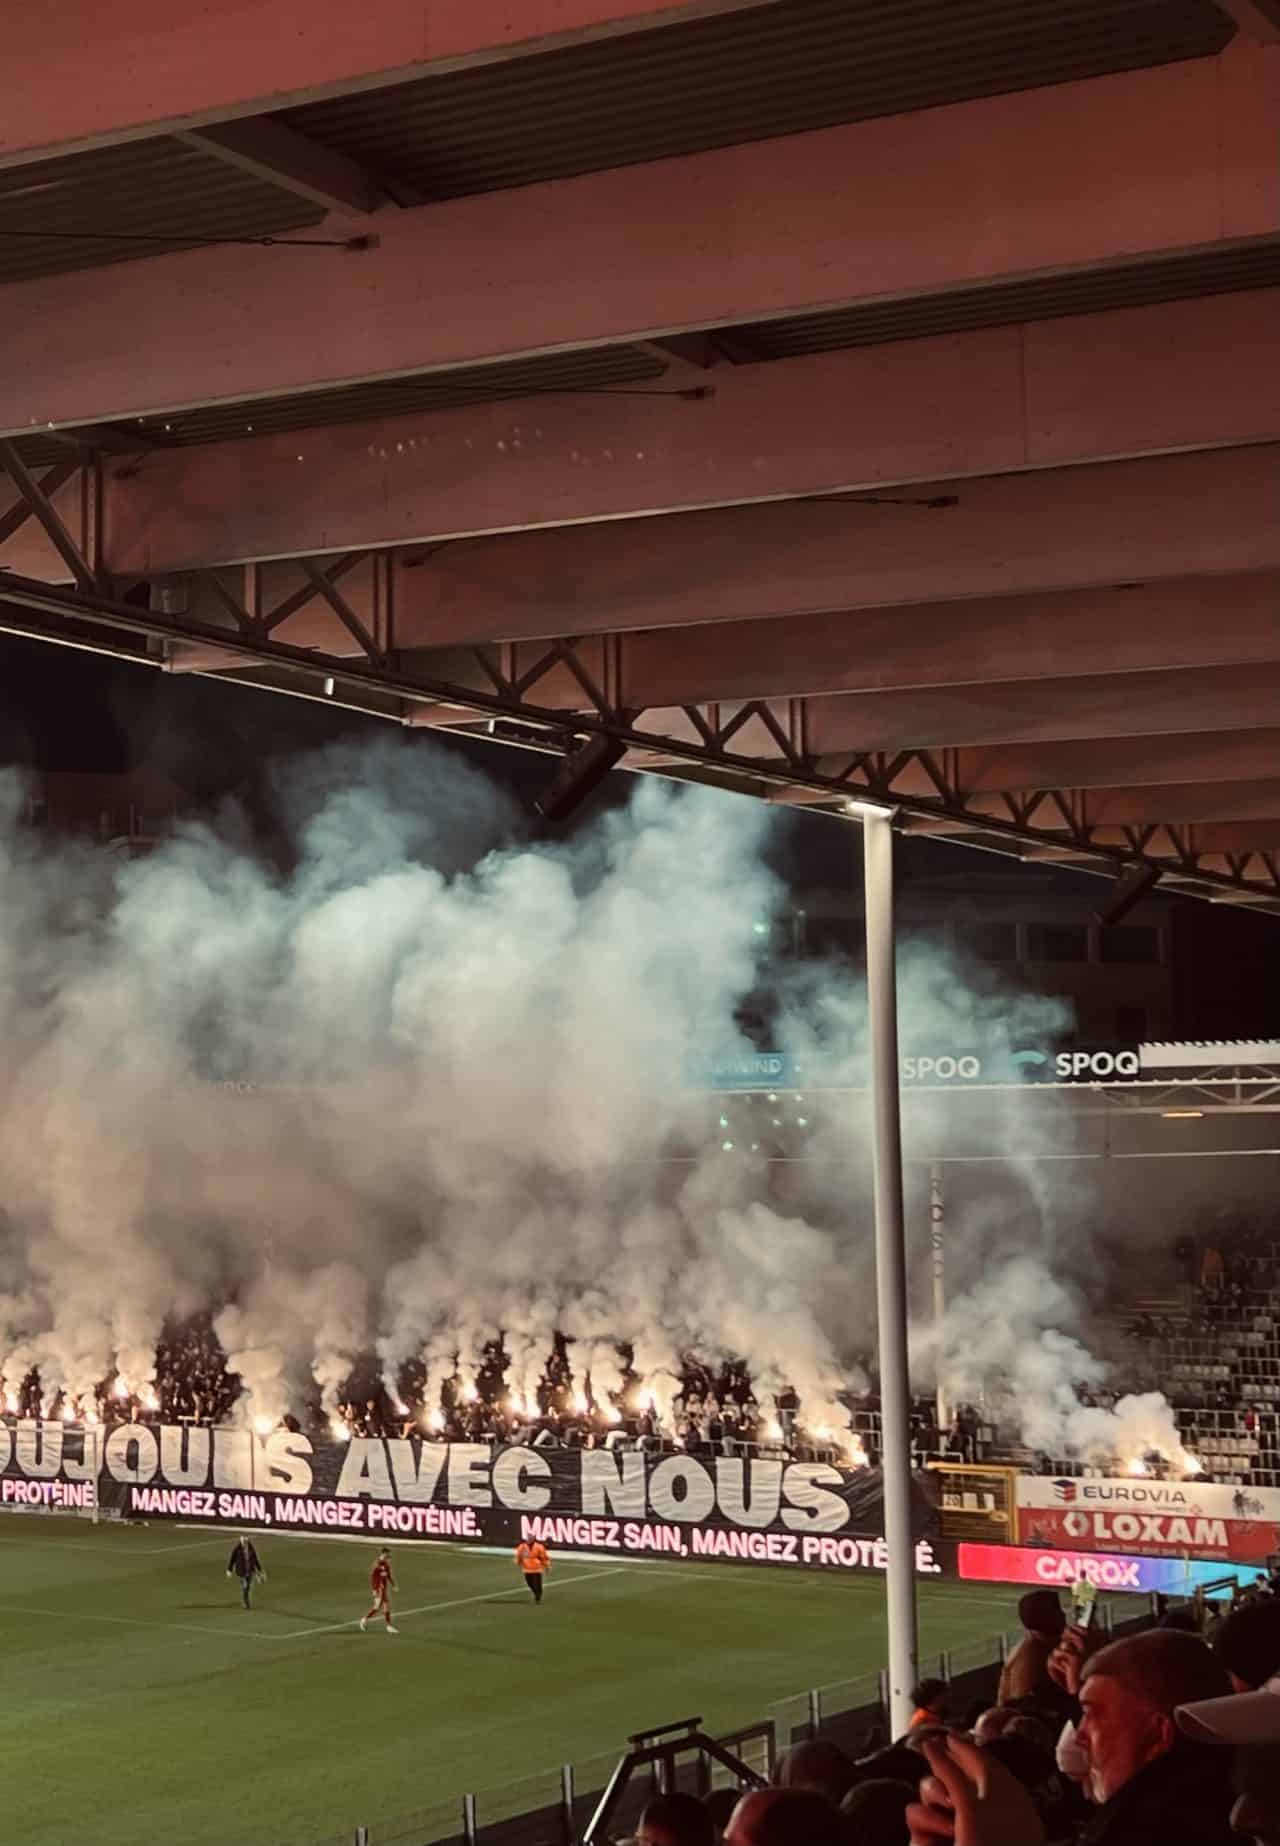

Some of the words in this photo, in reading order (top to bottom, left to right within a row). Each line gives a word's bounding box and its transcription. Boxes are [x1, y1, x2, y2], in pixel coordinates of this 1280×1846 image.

[903, 1056, 981, 1079] SPOQ
[1055, 1052, 1139, 1077] SPOQ
[335, 1437, 552, 1510] AVEC
[580, 1449, 851, 1532] NOUS
[1083, 1485, 1186, 1504] EUROVIA
[132, 1488, 215, 1516] MANGEZ
[219, 1493, 271, 1524] SAIN,
[275, 1498, 363, 1528] MANGEZ
[368, 1503, 482, 1537] PROTÉINÉ.
[521, 1515, 620, 1547] MANGEZ
[624, 1523, 688, 1556] SAIN,
[692, 1528, 798, 1562] MANGEZ
[803, 1537, 942, 1573] PROTÉÉ.
[1094, 1512, 1228, 1547] LOXAM
[1036, 1556, 1140, 1587] CAIROX
